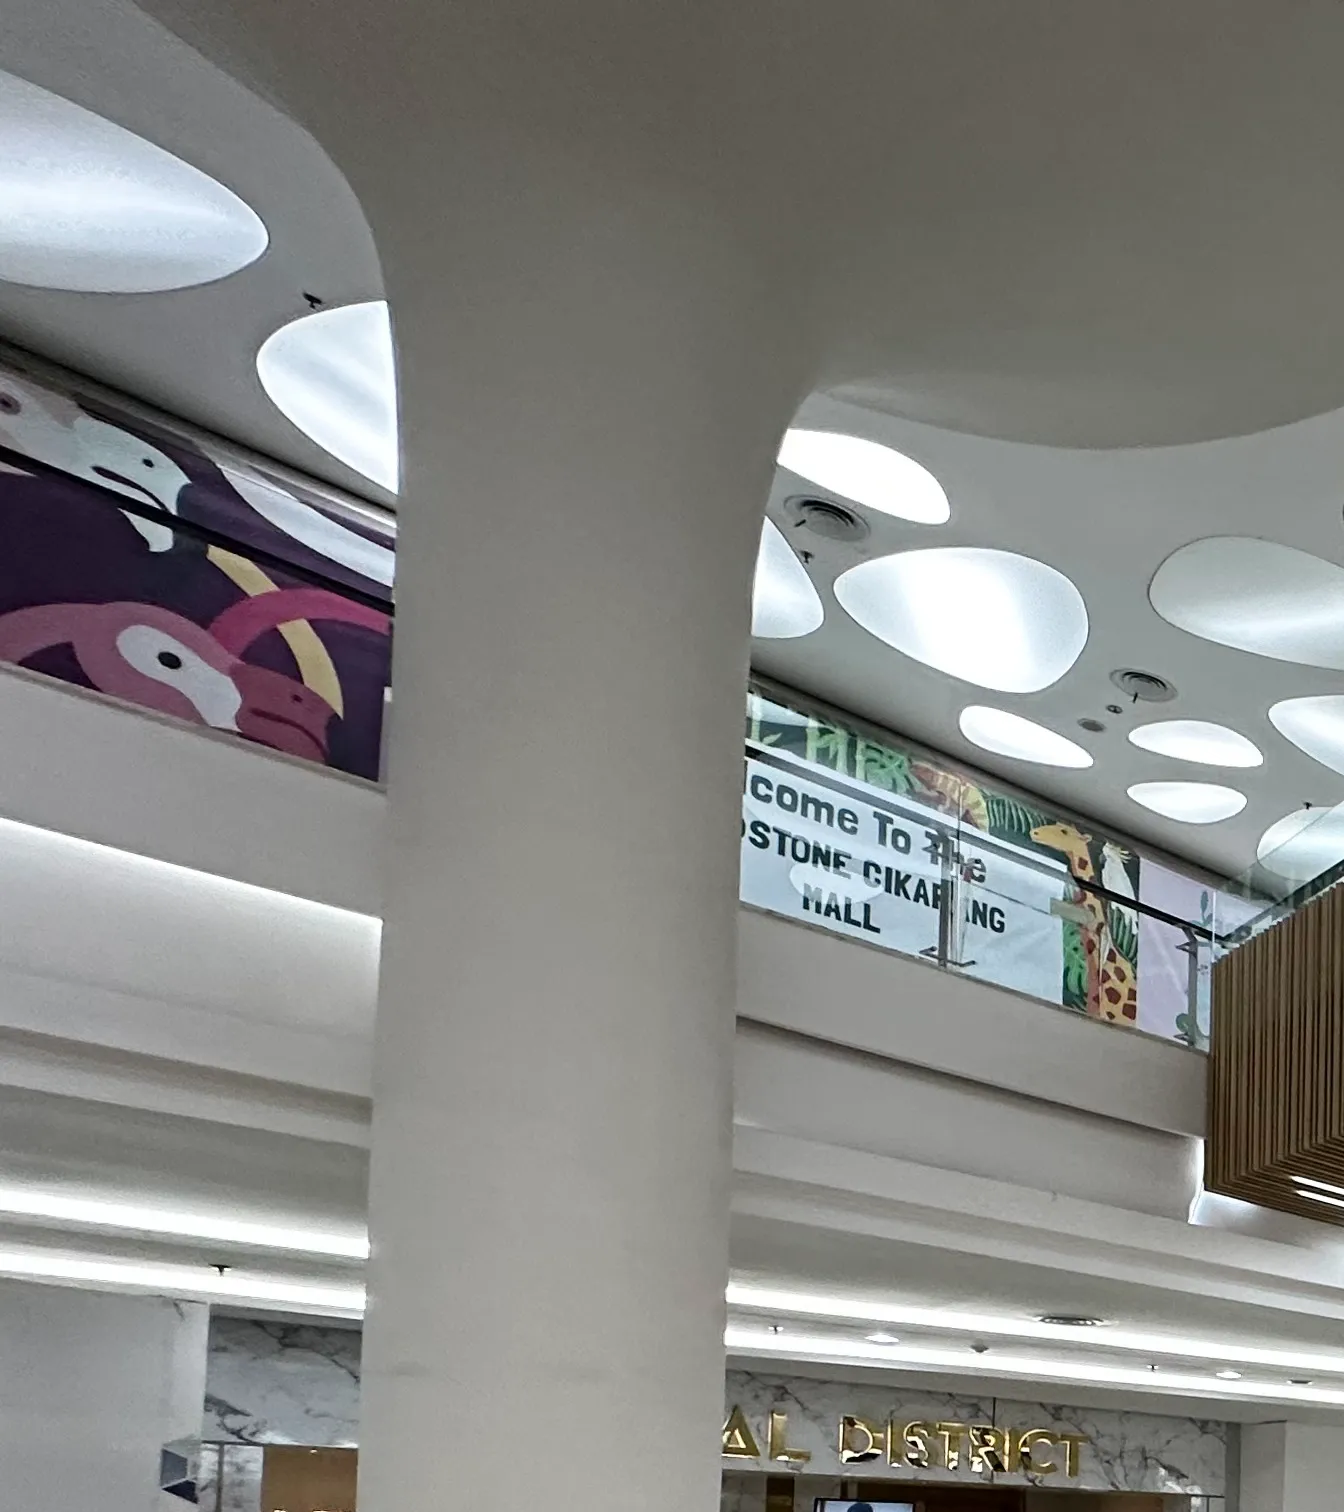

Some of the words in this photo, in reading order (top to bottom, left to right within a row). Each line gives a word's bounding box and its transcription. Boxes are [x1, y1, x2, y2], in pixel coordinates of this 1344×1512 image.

[873, 809, 912, 855] To
[925, 830, 987, 884] The
[802, 882, 881, 934] MALL
[839, 1413, 1091, 1479] DISTRICT
